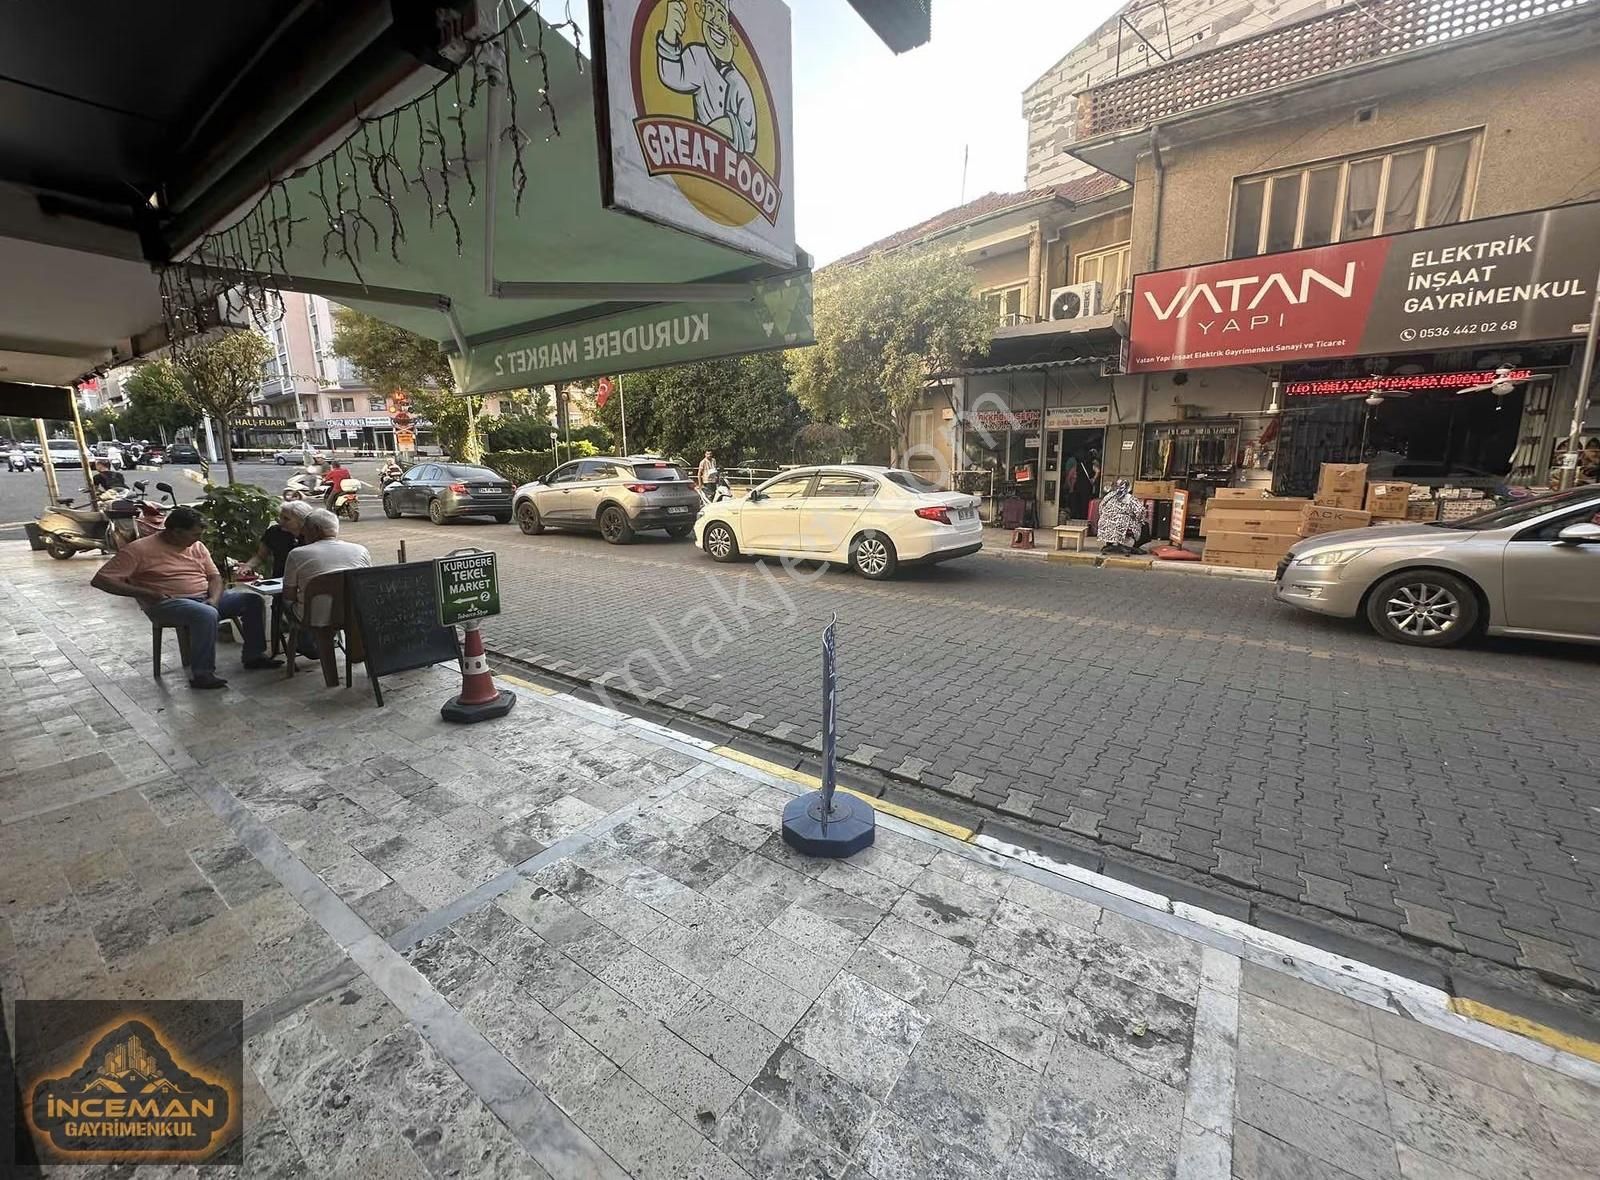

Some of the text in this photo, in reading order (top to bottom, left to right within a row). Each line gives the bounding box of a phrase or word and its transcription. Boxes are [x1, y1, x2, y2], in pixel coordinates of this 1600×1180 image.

[643, 124, 777, 214] GREAT FOOD
[1411, 235, 1535, 268] ELEKTRİK
[1407, 265, 1497, 291] İNŞAAT
[1144, 262, 1356, 320] VATAN
[1404, 279, 1587, 313] GAYRİMENKUL
[1198, 313, 1284, 335] YAPI
[1419, 320, 1518, 338] 0536 442 02 68
[1194, 349, 1223, 358] Elektrik
[1225, 345, 1274, 356] Gayrimenkul
[1275, 343, 1302, 353] Sanayi
[1316, 339, 1346, 348] Ticaret
[259, 419, 286, 427] FUARI
[443, 557, 492, 572] KURUDERE
[452, 568, 487, 582] TEKEL
[450, 579, 491, 595] MARKET
